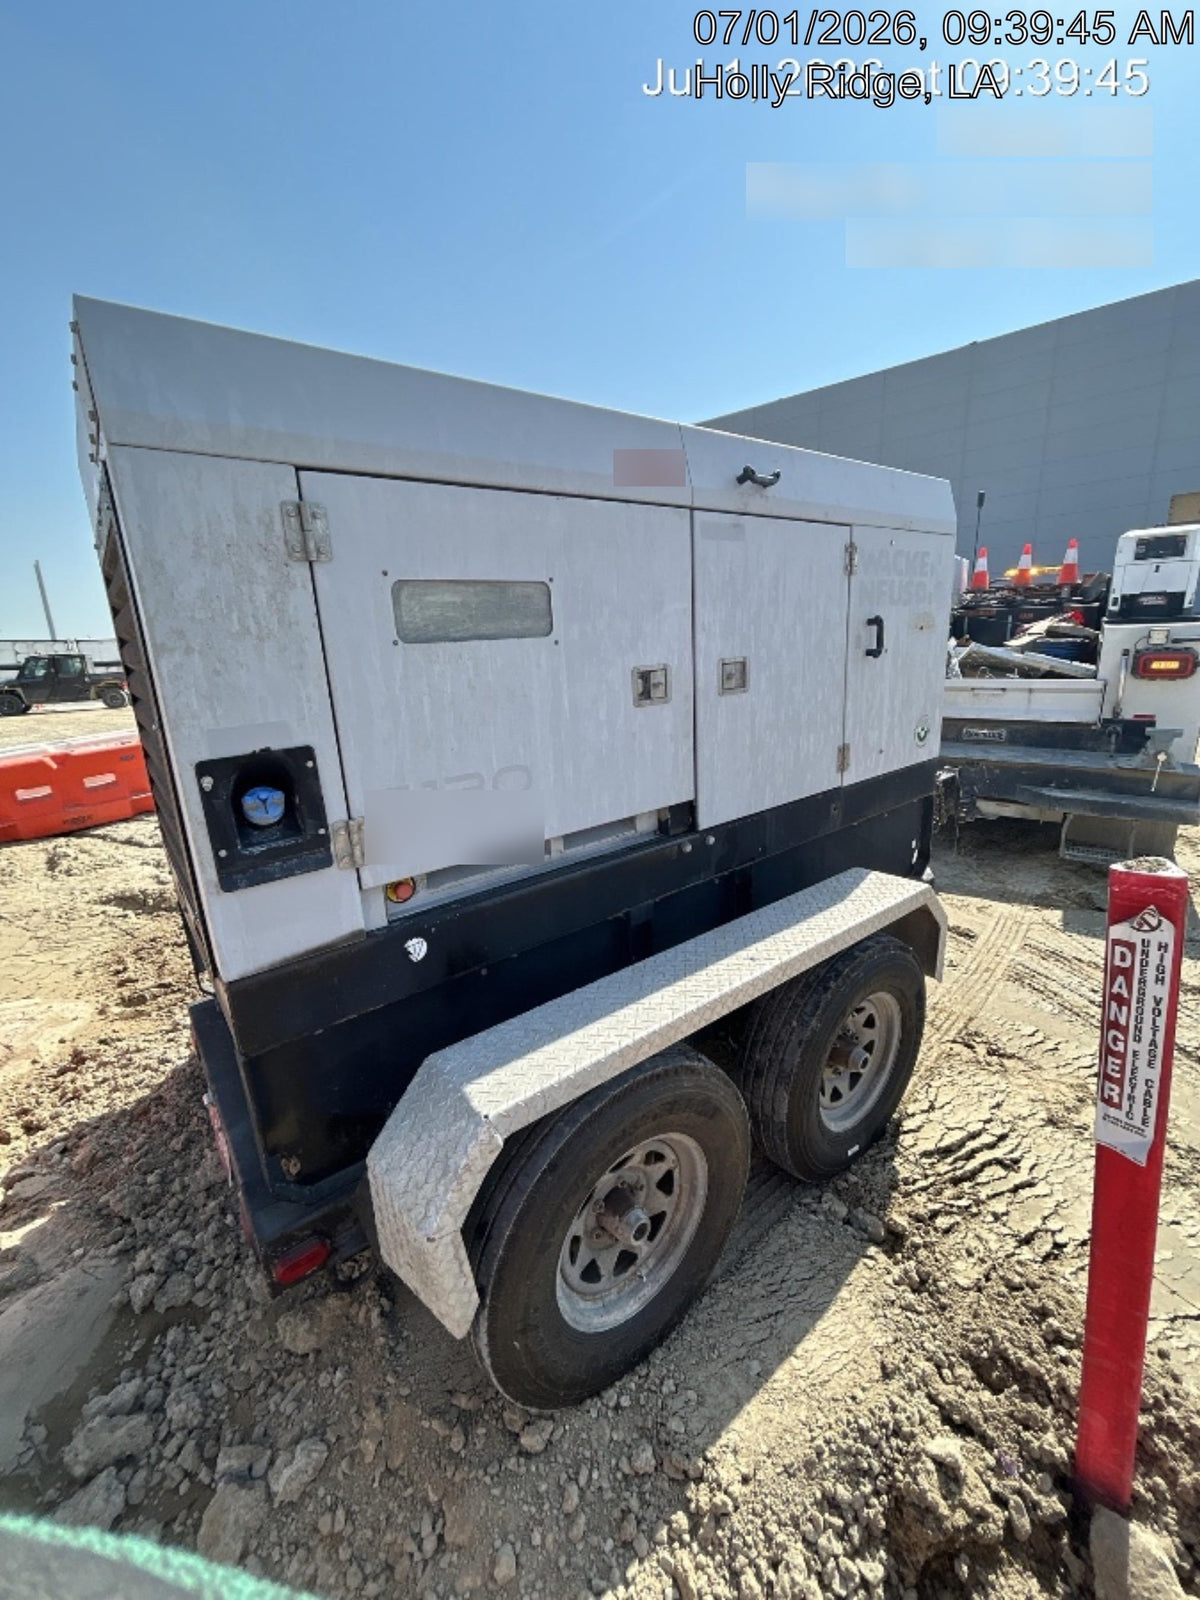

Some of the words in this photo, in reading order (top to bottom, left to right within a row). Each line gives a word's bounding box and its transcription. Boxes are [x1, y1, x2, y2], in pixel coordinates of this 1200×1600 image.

[1132, 938, 1150, 1043] UNDERGROUND
[1155, 942, 1168, 985] HIGH
[1103, 945, 1132, 1105] DANGER
[1147, 995, 1163, 1069] VOLTAGE
[1125, 1050, 1140, 1120] ELECTRIC
[1141, 1079, 1155, 1128] CABLE
